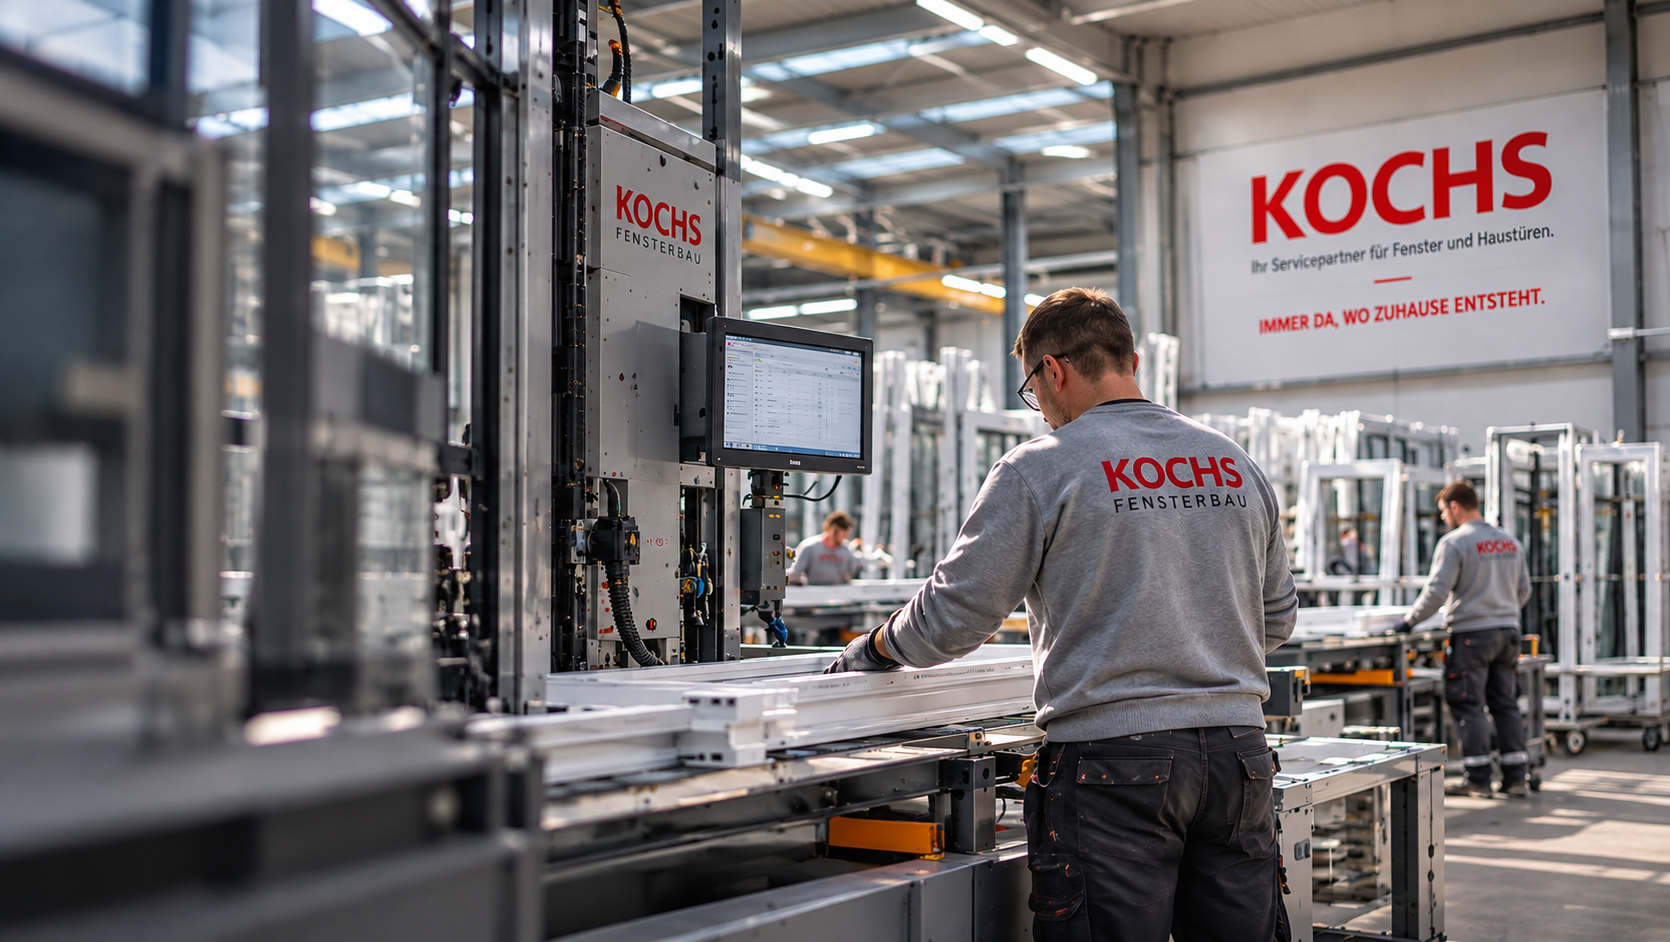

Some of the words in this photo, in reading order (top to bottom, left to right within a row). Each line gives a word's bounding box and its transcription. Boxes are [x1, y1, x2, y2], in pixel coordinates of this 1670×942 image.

[1251, 131, 1552, 244] KOCHS
[616, 184, 702, 246] KOCHS
[616, 226, 701, 264] FENSTERBAU
[1251, 259, 1268, 275] Ihr
[1271, 249, 1366, 273] Servicepartner
[1369, 243, 1389, 260] für
[1393, 238, 1443, 257] Fenster
[1447, 232, 1473, 251] und
[1477, 224, 1554, 247] Haustüren.
[1259, 314, 1309, 334] IMMER
[1313, 311, 1339, 330] DA,
[1343, 307, 1370, 325] WO
[1374, 298, 1449, 322] ZUHAUSE
[1454, 287, 1545, 313] ENTSTEHT.
[1101, 456, 1243, 493] KOCHS
[1113, 493, 1247, 513] FENSTERBAU
